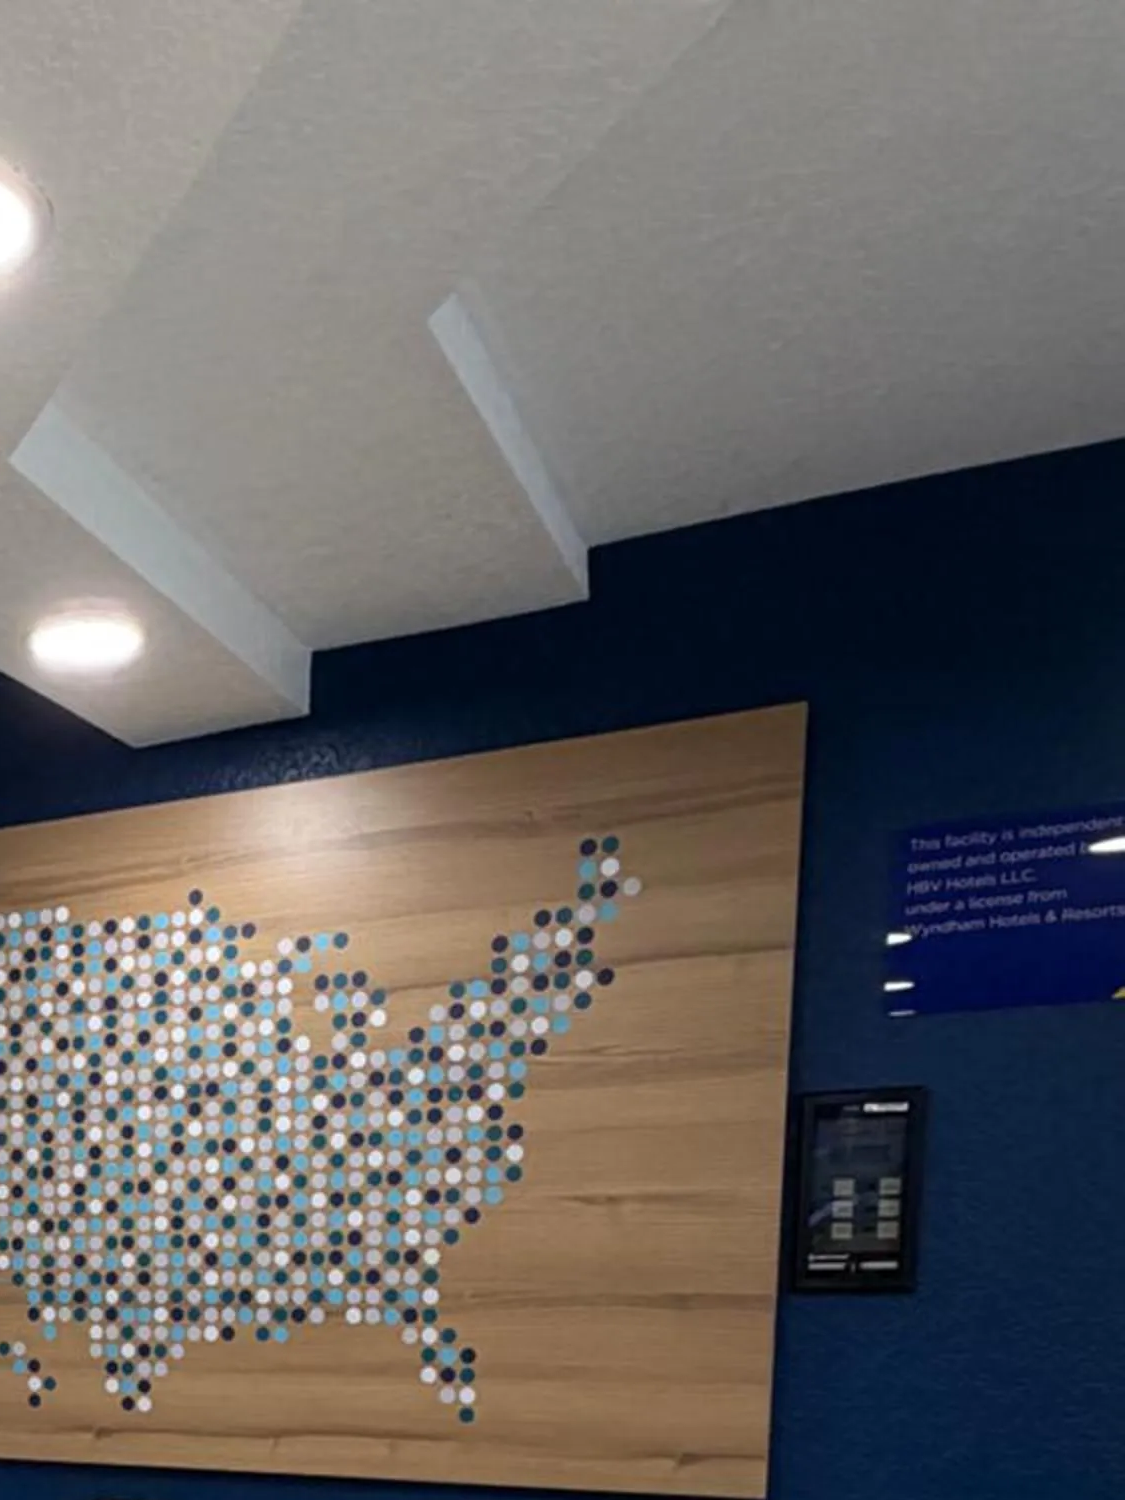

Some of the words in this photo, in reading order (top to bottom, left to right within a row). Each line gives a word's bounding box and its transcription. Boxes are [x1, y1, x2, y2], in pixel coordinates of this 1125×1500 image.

[911, 838, 941, 851] This
[945, 831, 997, 849] facility
[1001, 829, 1014, 841] is
[907, 856, 962, 874] owned
[965, 852, 996, 868] and
[999, 841, 1076, 865] operated
[945, 874, 996, 890] Hotels
[1000, 868, 1038, 884] LLC
[905, 900, 951, 916] under
[954, 899, 966, 911] a
[968, 895, 1024, 909] license
[1027, 889, 1068, 903] from
[989, 912, 1041, 929] Hotels
[1045, 908, 1058, 923] &
[1061, 904, 1125, 923] Resorts
